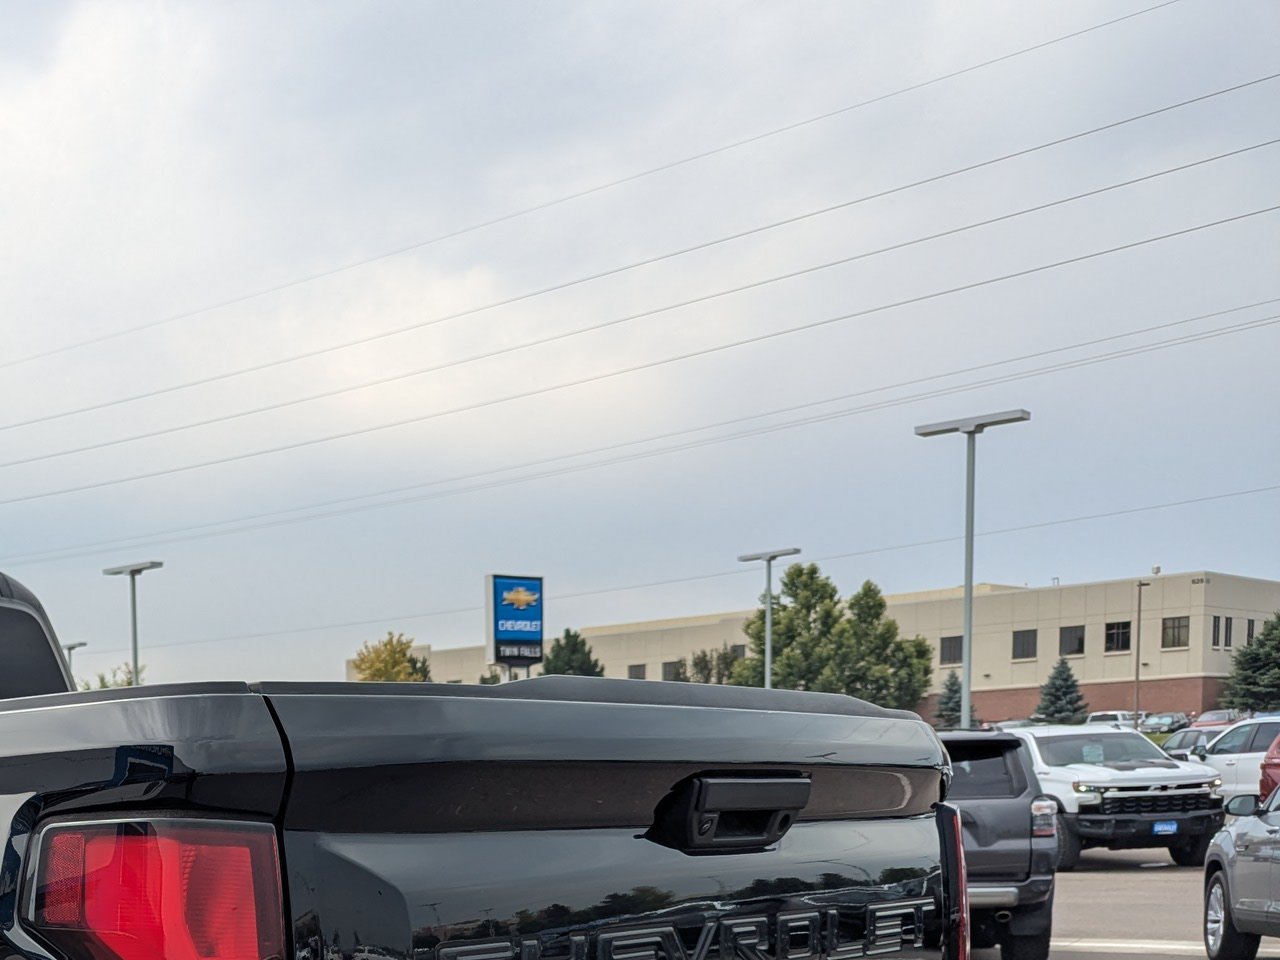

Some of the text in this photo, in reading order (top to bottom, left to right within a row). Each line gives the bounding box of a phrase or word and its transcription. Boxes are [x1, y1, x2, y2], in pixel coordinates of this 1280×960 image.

[498, 619, 541, 632] CHEVROLET
[499, 646, 541, 658] TWIN FALLS
